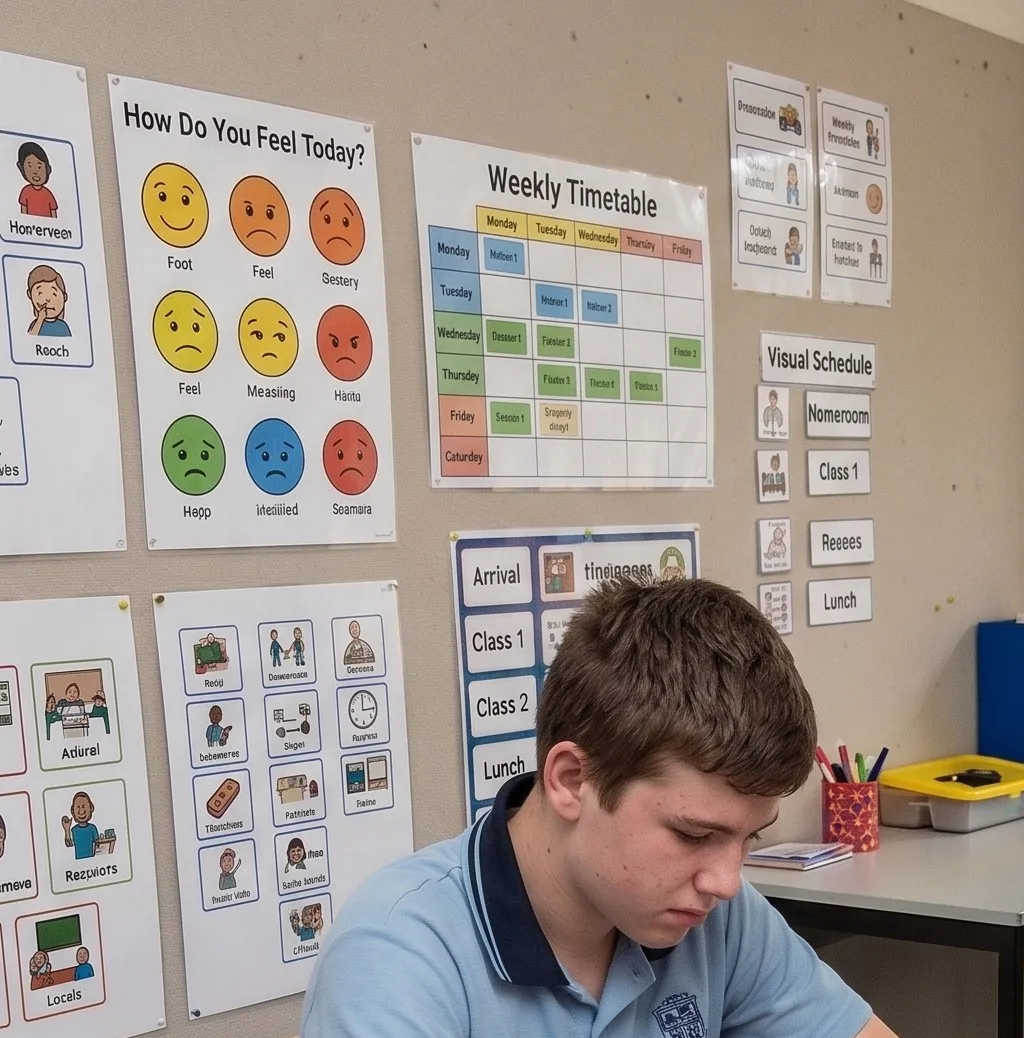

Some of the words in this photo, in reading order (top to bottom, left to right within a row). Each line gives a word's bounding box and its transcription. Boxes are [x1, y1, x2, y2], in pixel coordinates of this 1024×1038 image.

[123, 101, 171, 133] How
[179, 111, 207, 139] Do
[212, 116, 251, 147] You
[257, 125, 297, 154] Feel
[301, 133, 365, 170] Today?
[488, 164, 561, 209] Weekly
[566, 178, 658, 218] Timetable
[486, 215, 518, 232] Monday
[536, 222, 567, 239] Tuesday
[578, 229, 619, 247] Wednesday
[437, 242, 470, 260] Monday
[167, 256, 193, 271] Foot
[252, 265, 274, 279] Feel
[440, 284, 473, 300] Tuesday
[437, 326, 481, 345] Wednesday
[768, 346, 809, 370] Visual
[813, 350, 873, 376] Schedule
[179, 382, 201, 395] Feel
[820, 462, 849, 480] Class
[852, 462, 858, 480] 1
[473, 563, 521, 586] Arrival
[824, 591, 857, 610] Lunch
[472, 631, 513, 652] Class
[517, 629, 525, 648] 1
[477, 697, 516, 717] Class
[520, 692, 528, 712] 2
[484, 755, 525, 780] Lunch
